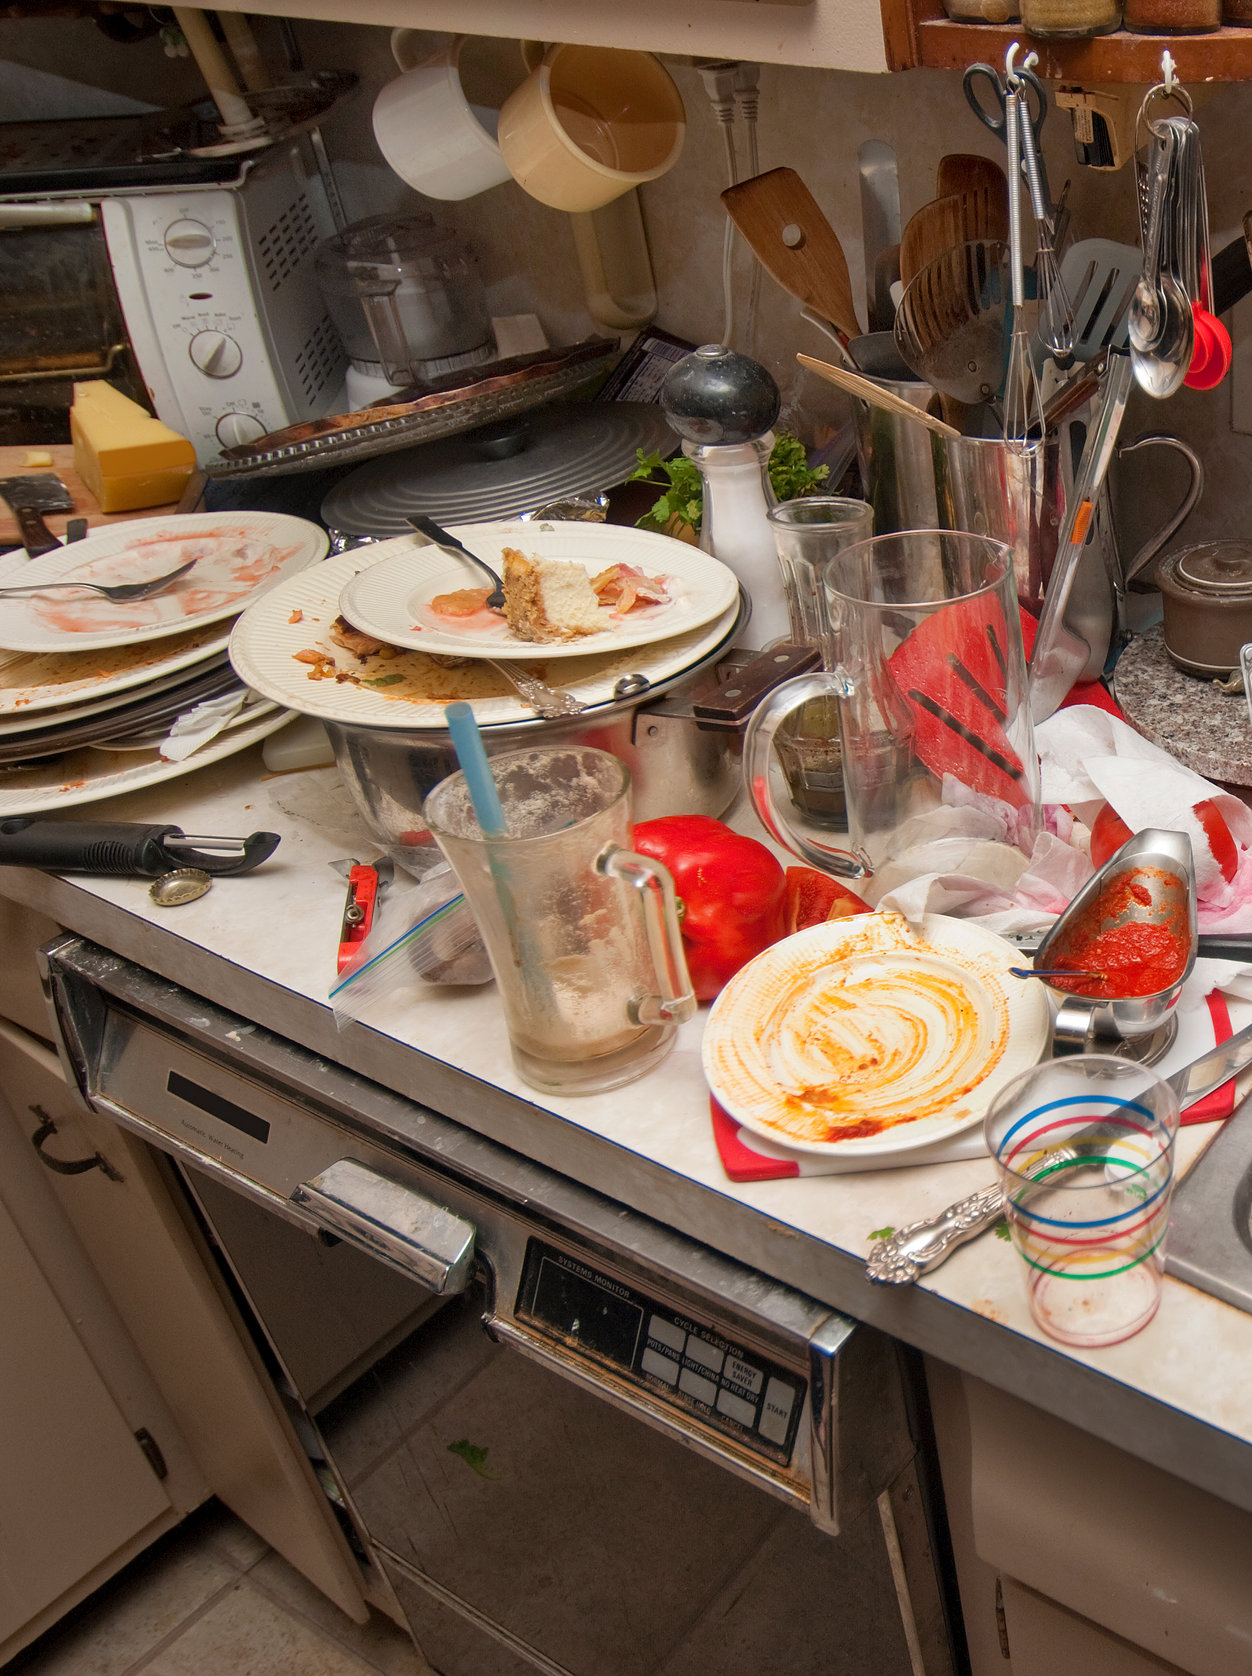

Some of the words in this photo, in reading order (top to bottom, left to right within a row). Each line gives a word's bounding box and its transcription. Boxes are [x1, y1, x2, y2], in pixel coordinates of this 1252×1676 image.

[559, 1255, 593, 1279] SYSTEMS
[594, 1274, 631, 1299] MONITOR
[673, 1316, 699, 1335] CYCLE
[701, 1330, 745, 1360] SELECTION
[647, 1338, 680, 1361] POTS/PANS
[731, 1360, 757, 1379] ENERGY
[732, 1370, 753, 1388] SAVER
[721, 1377, 731, 1390] NO
[730, 1383, 746, 1398] HEAT
[766, 1402, 788, 1419] START
